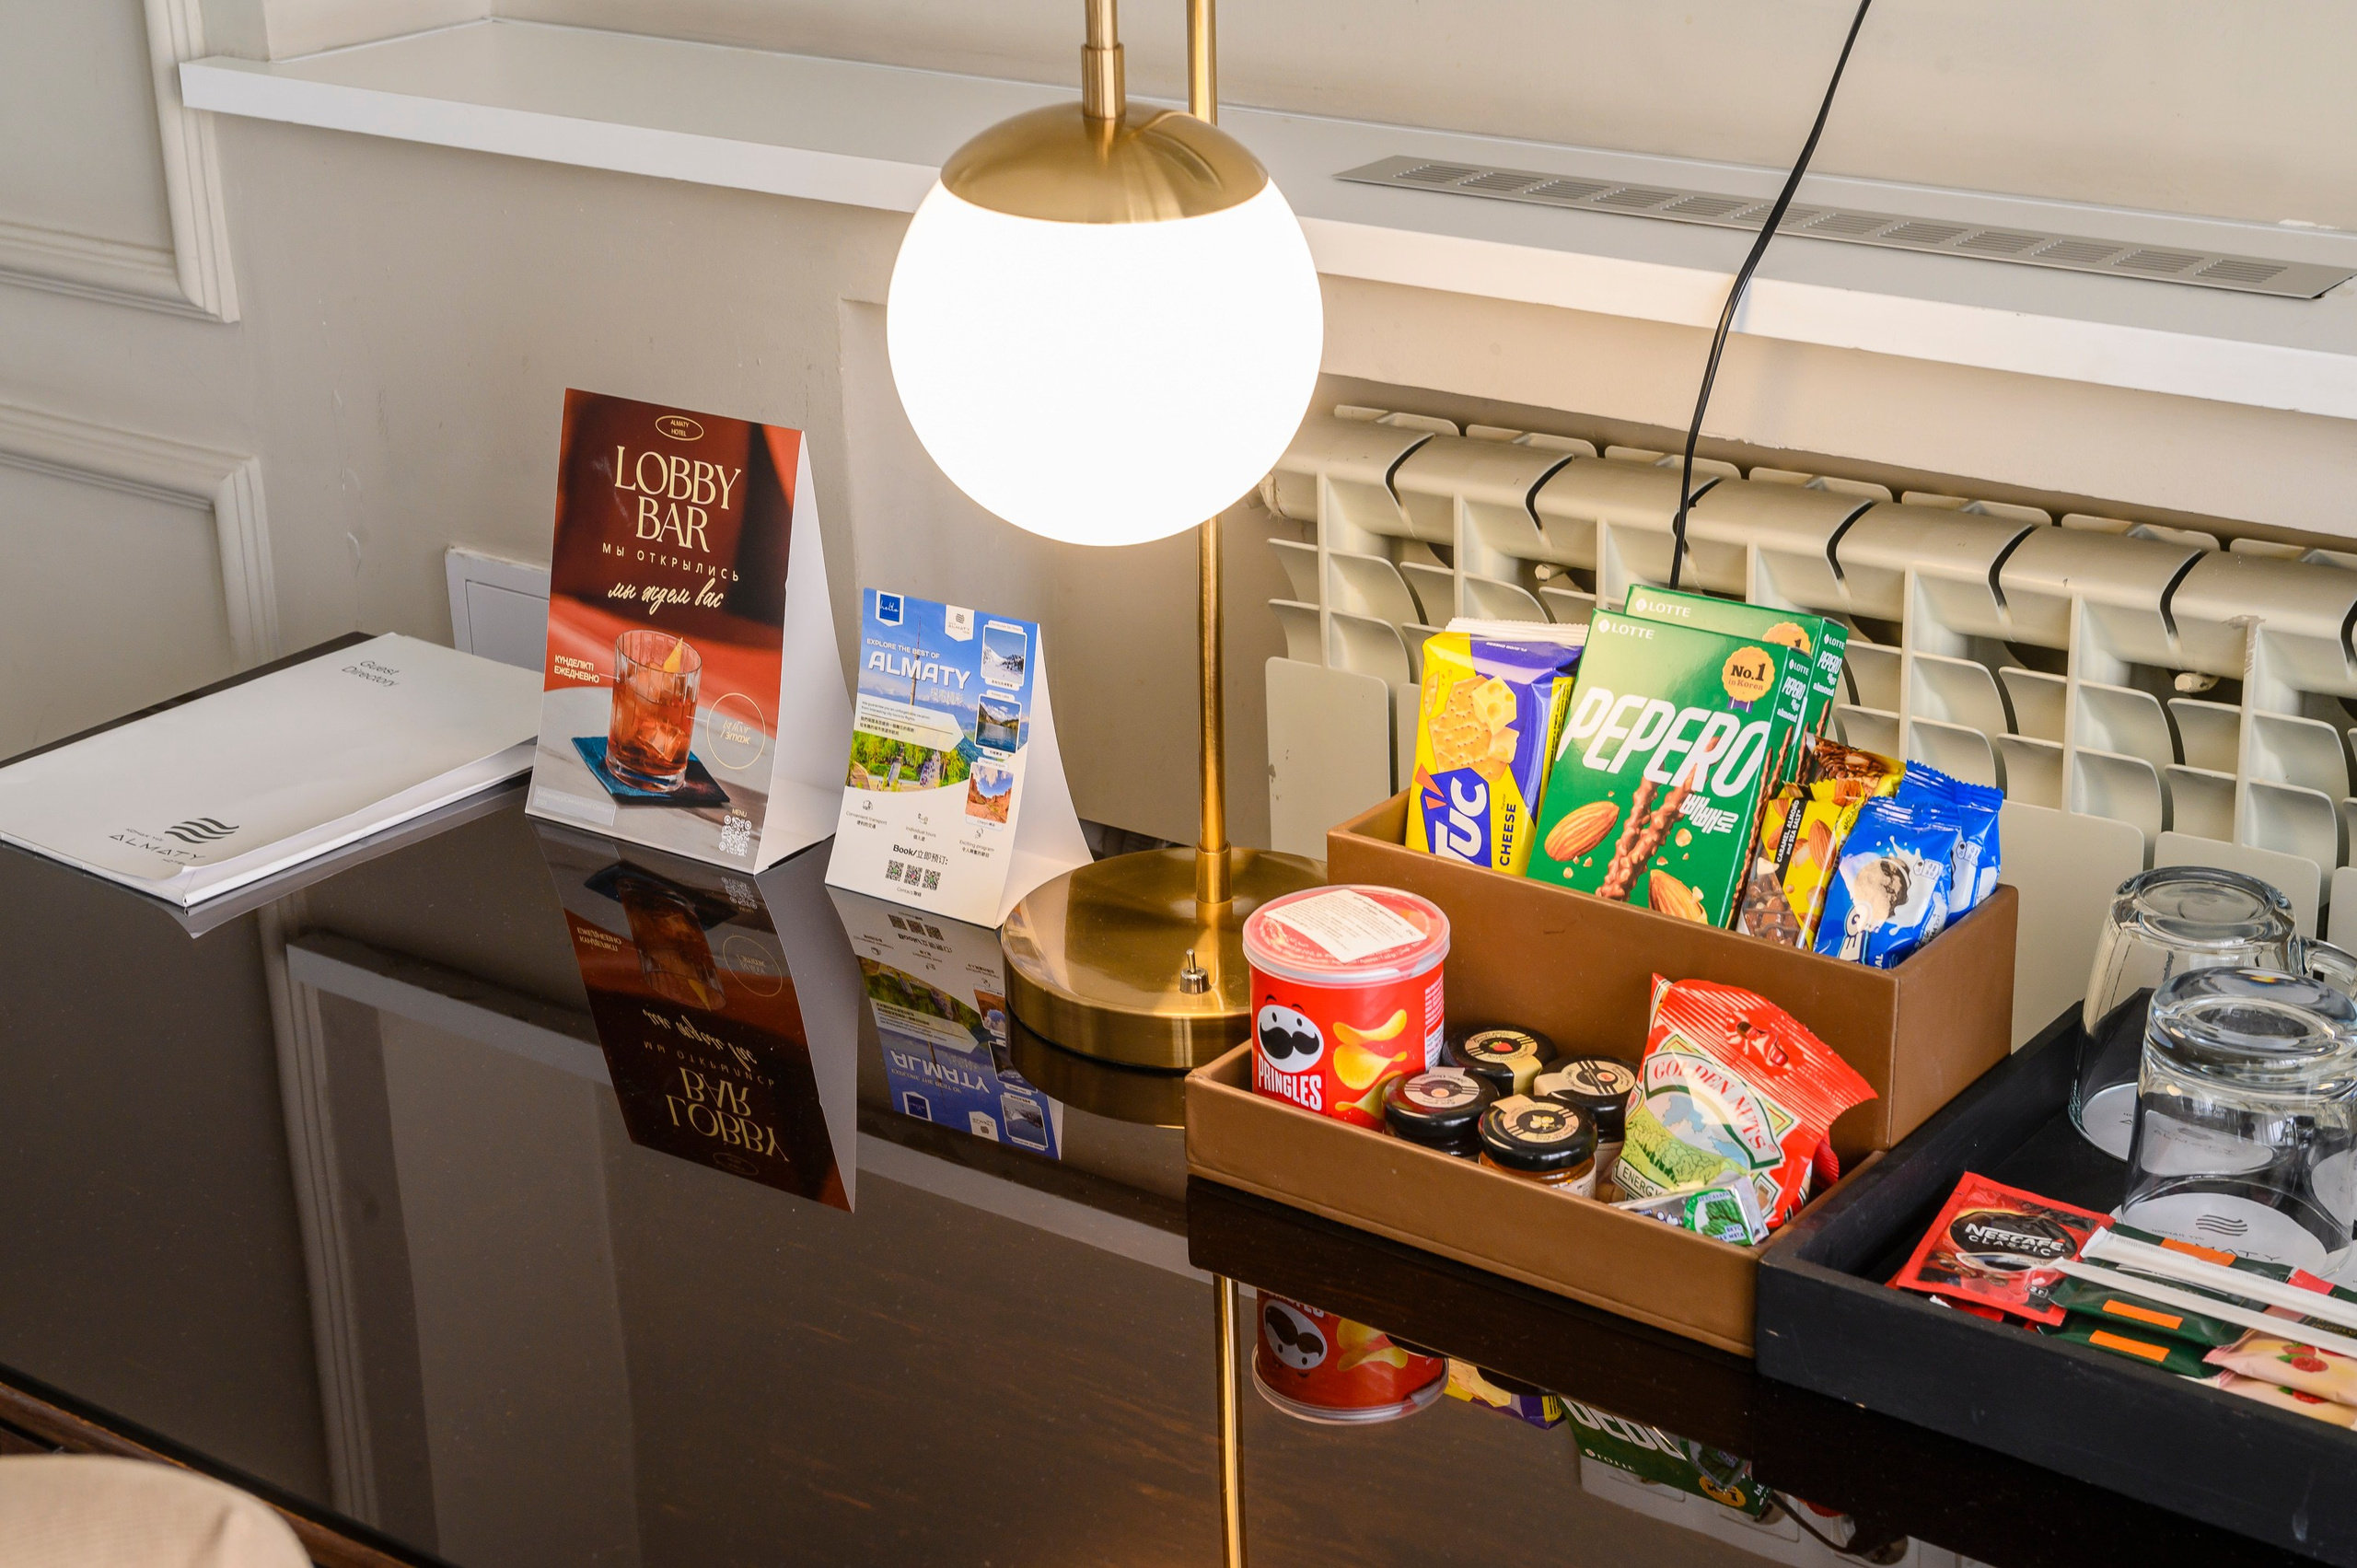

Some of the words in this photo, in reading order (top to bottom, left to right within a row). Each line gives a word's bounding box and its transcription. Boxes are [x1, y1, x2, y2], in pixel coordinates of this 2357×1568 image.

[670, 419, 690, 428] ALMATY
[671, 428, 687, 437] HOTEL
[614, 446, 741, 510] LOBBY
[635, 495, 710, 552] BAR
[603, 542, 624, 556] МЫ
[637, 550, 738, 581] ОТКРЫЛИСЬ
[608, 582, 636, 598] мы
[642, 585, 691, 615] ждем
[694, 577, 724, 608] вас
[880, 600, 899, 612] hello
[1647, 601, 1691, 618] LOTTE
[1611, 624, 1655, 641] LOTTE
[866, 638, 897, 651] EXPLORE
[898, 645, 911, 654] THE
[912, 648, 929, 656] BEST
[1829, 637, 1845, 650] LOTTE
[868, 651, 971, 690] ALMATY
[1794, 662, 1810, 676] LOTTE
[1817, 650, 1842, 675] PEPERO
[554, 665, 599, 683] ЕЖЕДНЕВНО
[1730, 663, 1766, 681] No.1
[1737, 679, 1763, 691] Korea
[1782, 676, 1806, 701] PEPERO
[1813, 682, 1835, 697] almond
[1777, 708, 1798, 723] almond
[1556, 686, 1771, 797] PEPERO
[732, 808, 747, 818] MENU
[846, 811, 868, 820] Convenient
[868, 816, 888, 825] transport
[1435, 776, 1488, 865] TUC
[1679, 794, 1739, 834] 빼빼로
[1786, 799, 1800, 829] ALMOND
[906, 826, 924, 835] Individual
[1500, 803, 1516, 866] CHEESE
[109, 834, 205, 860] ALMATY
[959, 839, 976, 848] Exciting
[1258, 1052, 1322, 1112] PRINGLES
[1654, 1059, 1735, 1095] GOLDEN
[1728, 1096, 1766, 1150] NUTS
[1968, 1235, 2051, 1256] CLASSIC
